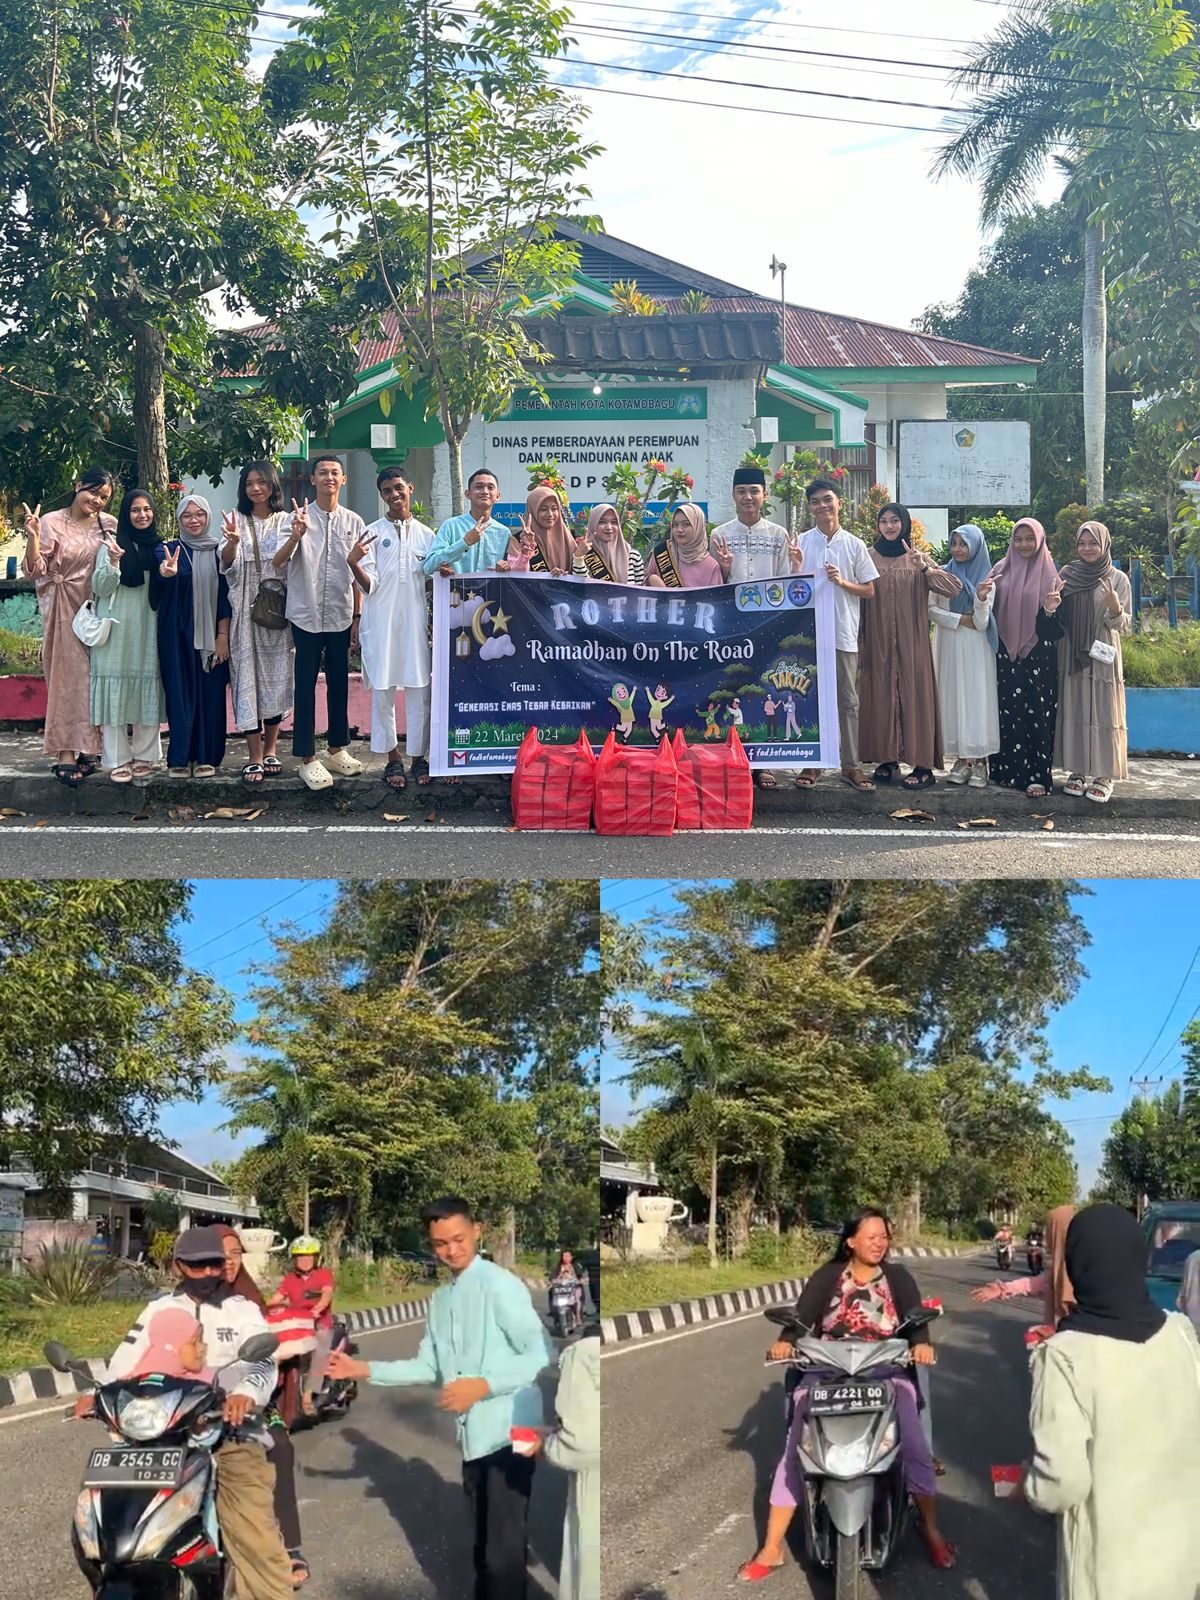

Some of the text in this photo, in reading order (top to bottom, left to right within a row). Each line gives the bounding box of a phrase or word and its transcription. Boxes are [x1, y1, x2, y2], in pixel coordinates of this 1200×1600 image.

[580, 399, 605, 410] KOTA
[608, 398, 675, 409] KOTAMOBAGU
[492, 435, 699, 448] DINAS PEMBERDAYAAN PEREMPUAN
[519, 451, 673, 463] DAN PERLINDUNGAN ANAK
[550, 596, 716, 634] ROTHER
[526, 638, 754, 663] Ramadhan On The Road
[510, 682, 535, 692] Tema
[475, 729, 559, 742] 22 Maret 024
[814, 1390, 828, 1400] DB
[94, 1453, 111, 1467] DB
[119, 1453, 153, 1467] 2545
